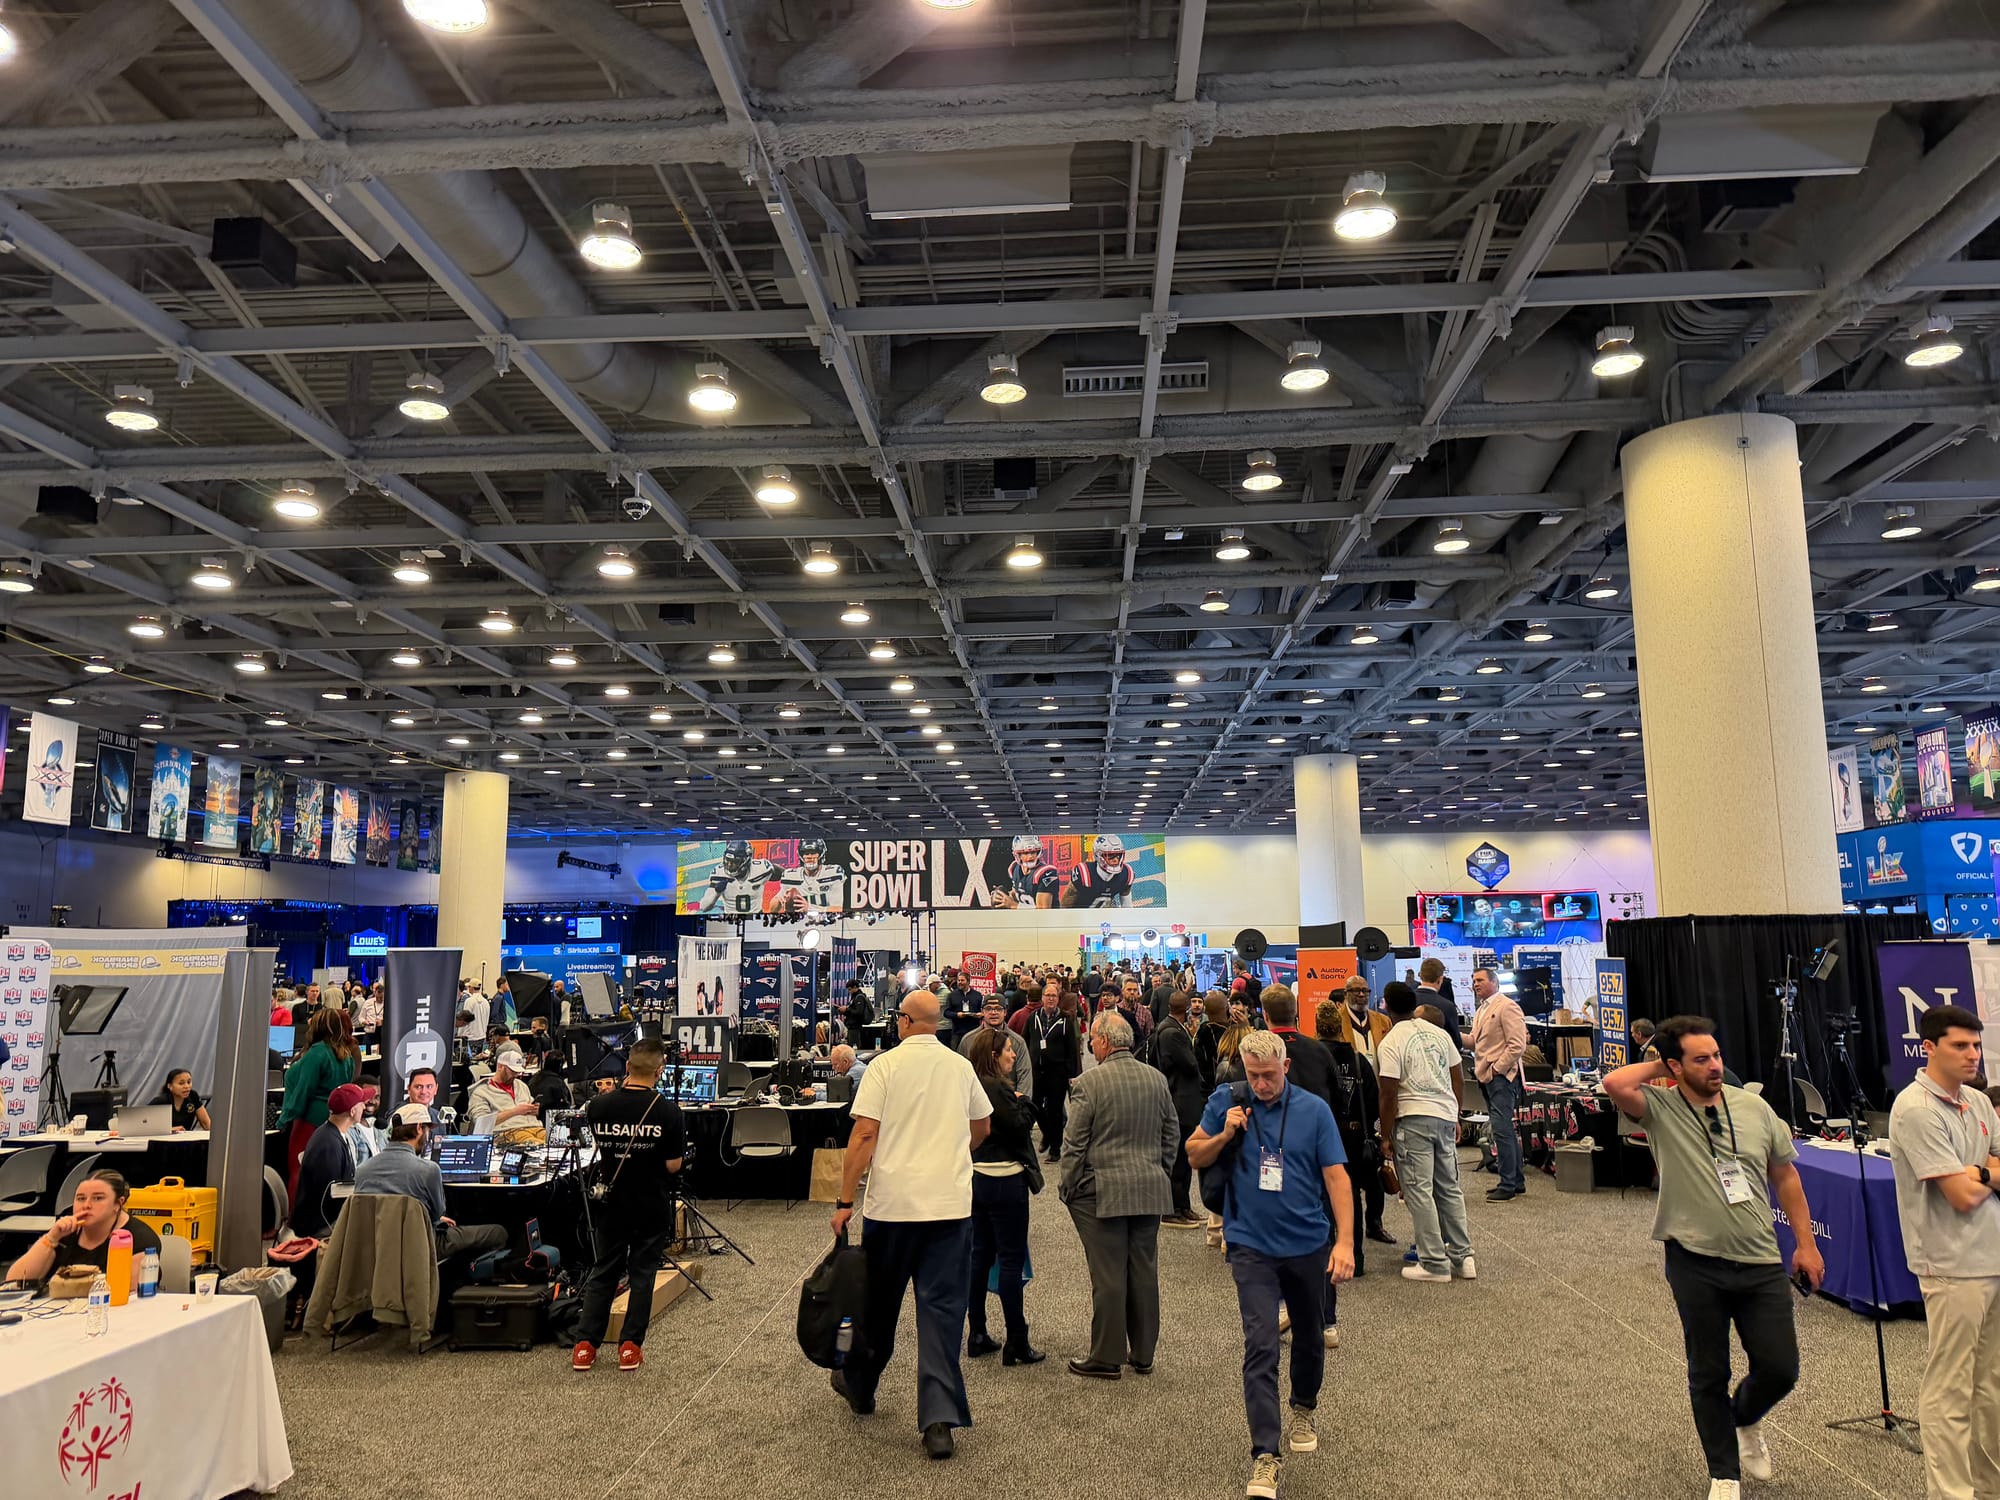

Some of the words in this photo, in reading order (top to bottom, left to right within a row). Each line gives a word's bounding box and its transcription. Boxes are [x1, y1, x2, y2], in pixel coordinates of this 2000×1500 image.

[1922, 806, 1955, 817] HOUSTON
[849, 840, 927, 872] SUPER
[931, 839, 993, 908] LX
[1955, 872, 1990, 880] OFFICIAL
[850, 873, 928, 910] BOWL
[16, 904, 31, 912] EXIT
[353, 935, 386, 946] LOWE'S
[638, 957, 667, 965] PATRIOTS
[566, 963, 615, 971] Livestreaming
[1320, 967, 1348, 975] Audacy
[1601, 974, 1622, 993] 95.7
[1600, 994, 1610, 1003] THE
[1610, 995, 1624, 1005] GAME
[416, 995, 431, 1035] THE
[1603, 1009, 1624, 1029] 95.7
[678, 1026, 722, 1053] 94.1
[1602, 1030, 1612, 1039] THE
[1612, 1030, 1625, 1041] GAME
[1604, 1043, 1625, 1065] 95.7
